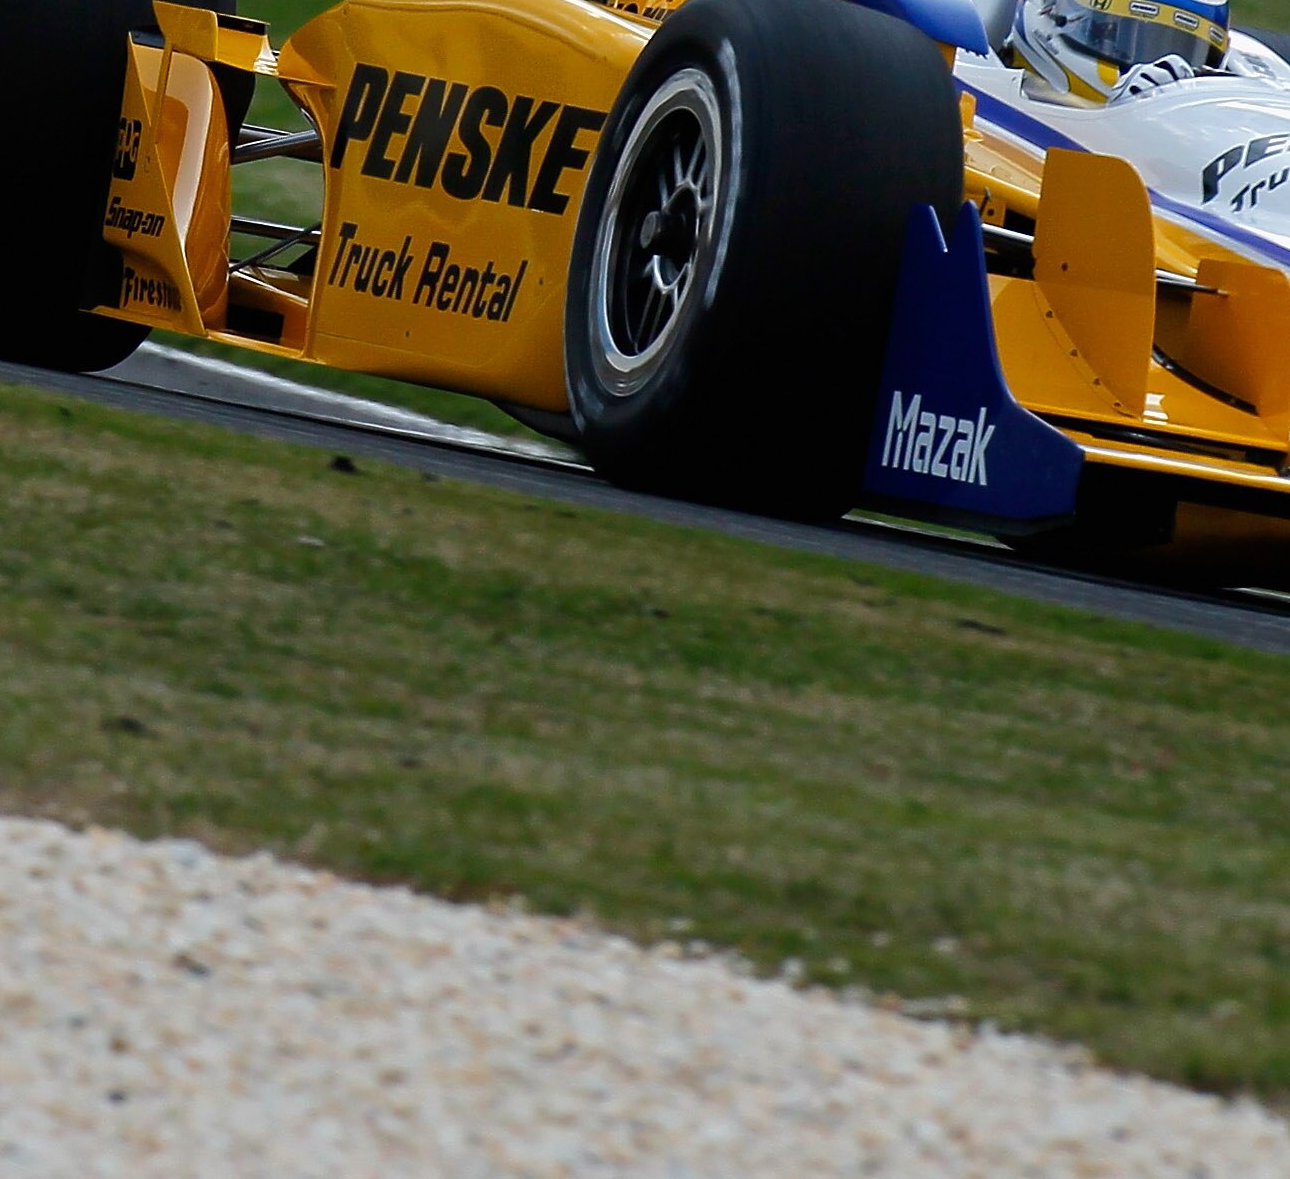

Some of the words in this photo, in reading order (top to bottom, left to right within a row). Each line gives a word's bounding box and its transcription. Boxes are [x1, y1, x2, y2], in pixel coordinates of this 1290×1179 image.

[330, 62, 609, 217] PENSKE
[104, 196, 166, 239] Snap-on
[328, 223, 414, 301] Truck
[412, 242, 528, 323] Rental
[880, 390, 997, 487] Mazak
